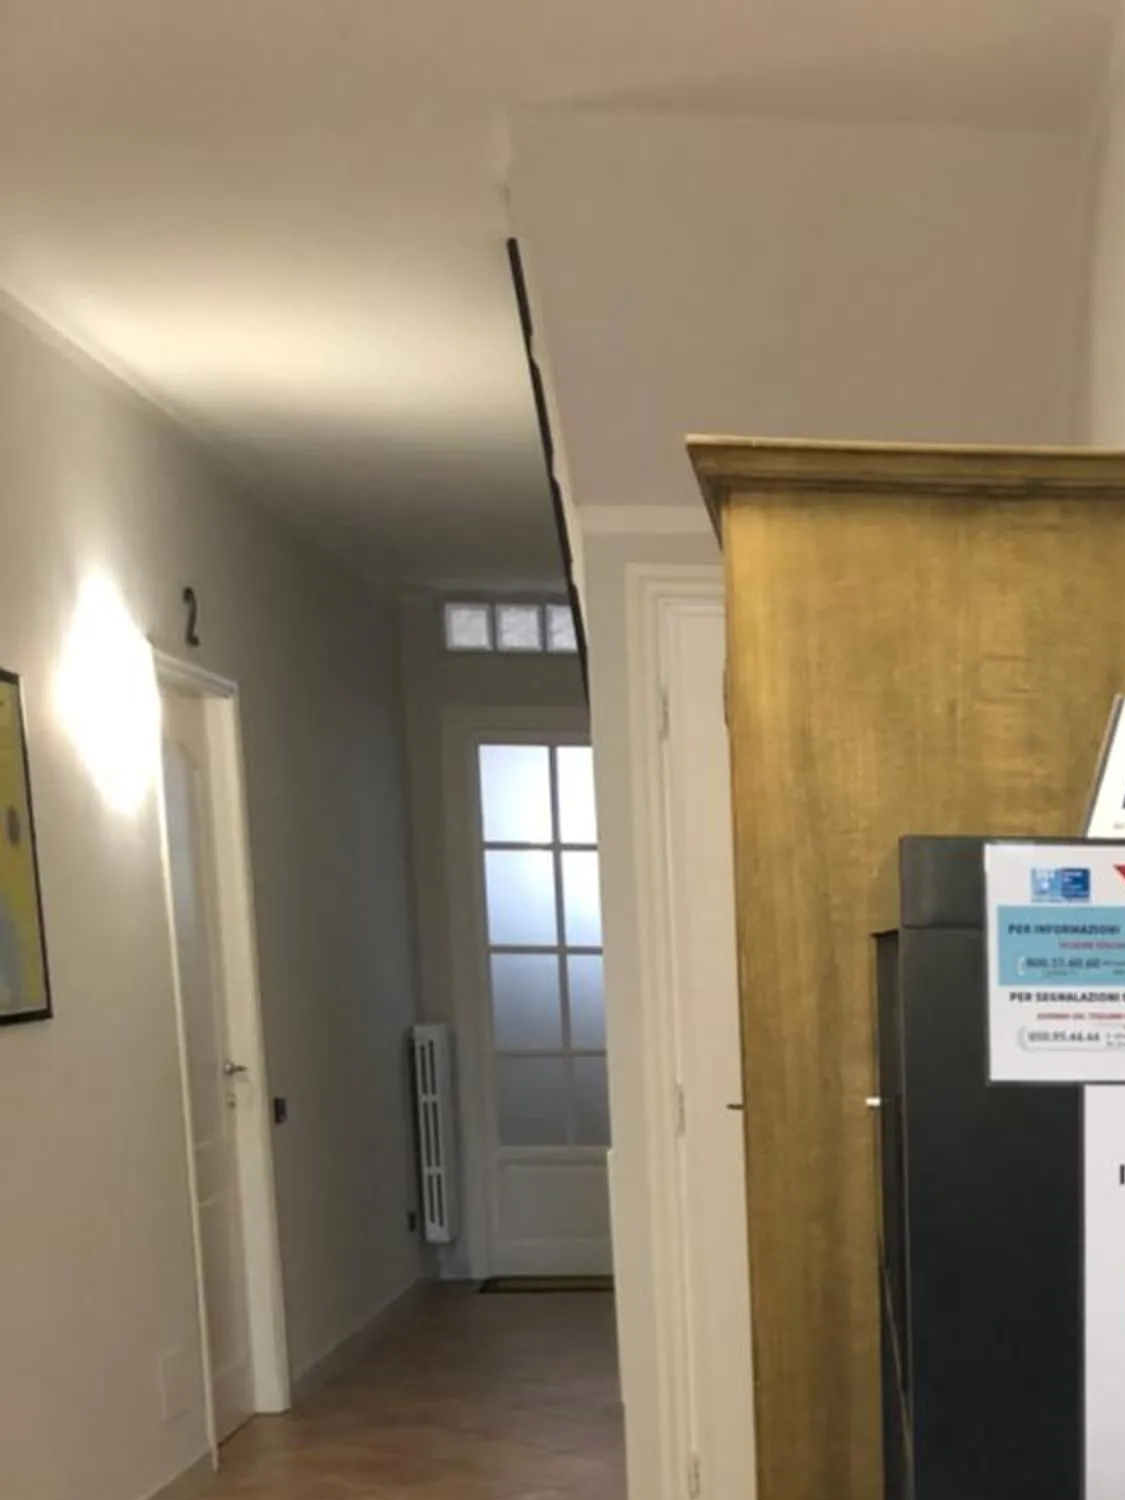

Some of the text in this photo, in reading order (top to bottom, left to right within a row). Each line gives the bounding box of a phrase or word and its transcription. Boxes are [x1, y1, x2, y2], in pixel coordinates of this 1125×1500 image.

[1008, 923, 1121, 936] PER INFORMAZIONI
[1009, 991, 1033, 1003] PER
[1035, 991, 1120, 1003] SEGNALAZIONI
